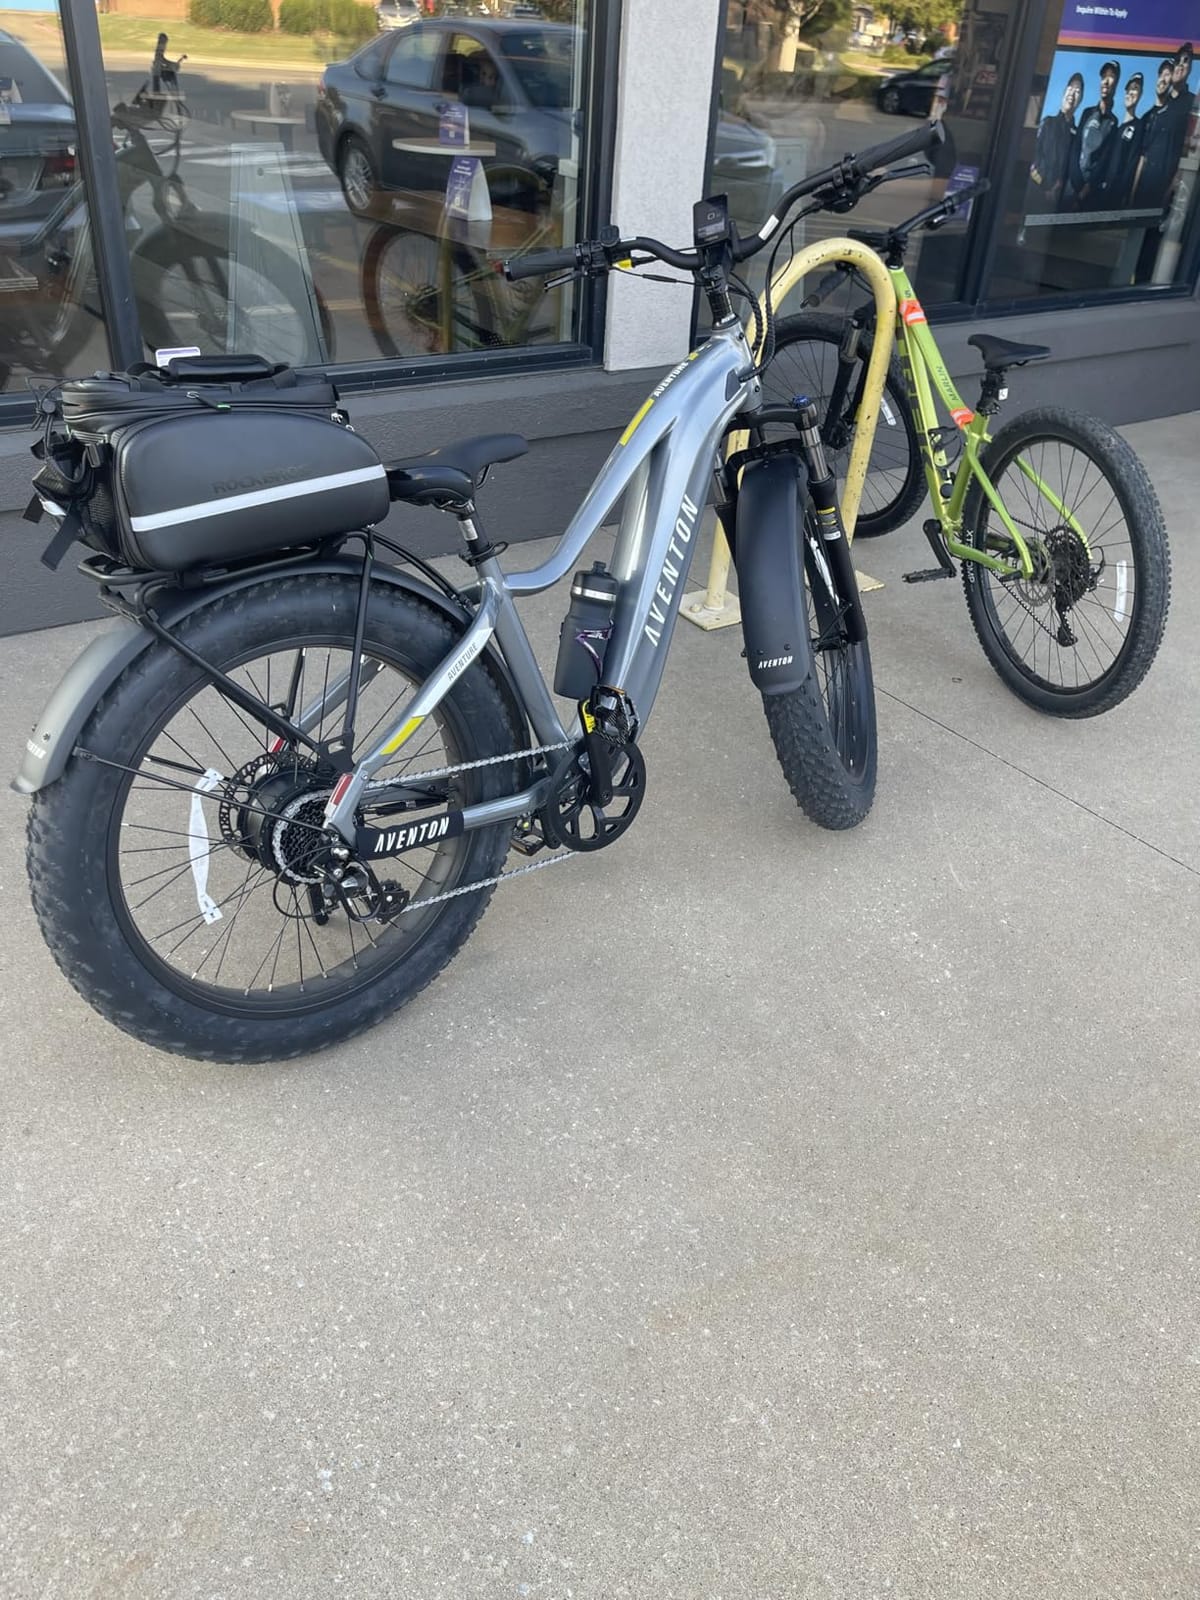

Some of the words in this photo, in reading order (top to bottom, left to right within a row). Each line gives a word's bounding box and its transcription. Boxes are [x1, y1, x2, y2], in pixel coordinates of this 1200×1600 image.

[653, 361, 689, 397] AVENTURE
[936, 366, 960, 401] MARLIN
[644, 494, 699, 647] AVENTON
[447, 641, 477, 680] AVENTURE
[757, 655, 793, 669] AVENTON
[373, 816, 449, 853] AVENTON
